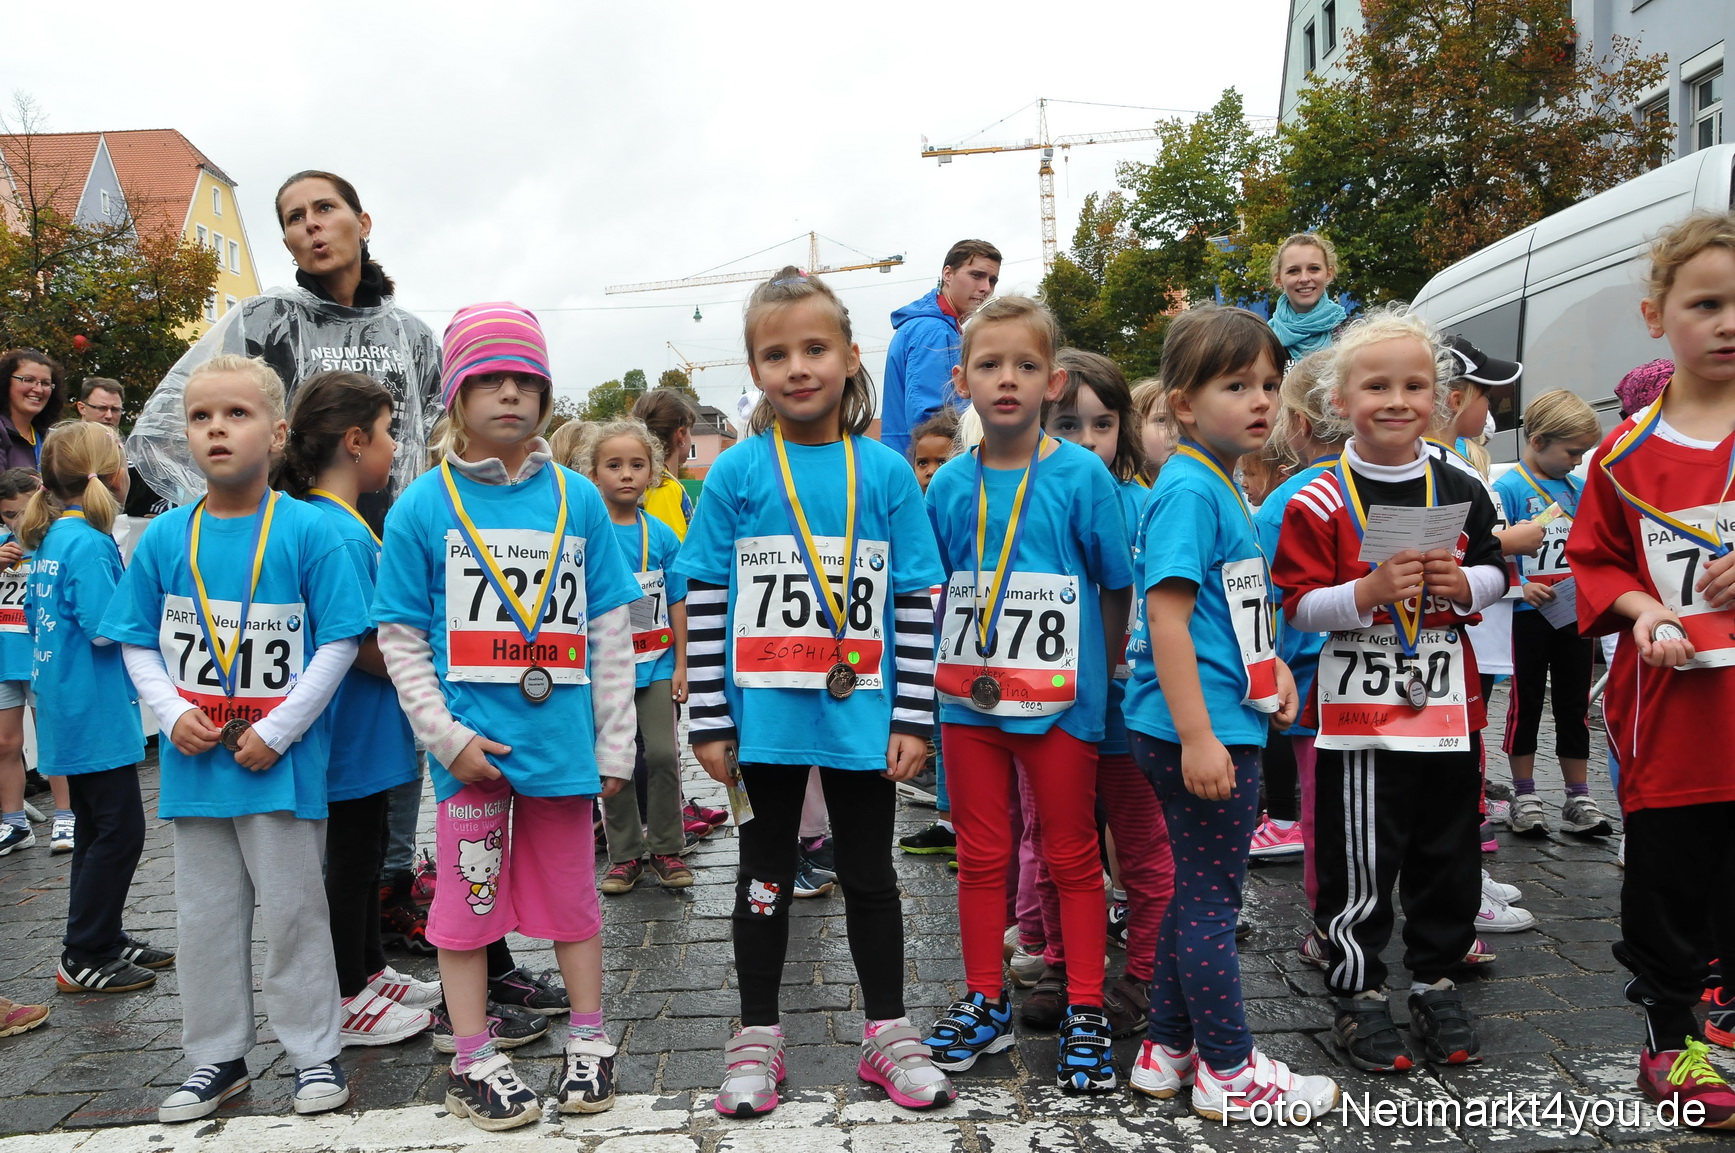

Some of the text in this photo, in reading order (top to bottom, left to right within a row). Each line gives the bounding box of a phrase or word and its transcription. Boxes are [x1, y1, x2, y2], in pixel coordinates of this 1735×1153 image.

[741, 551, 786, 566] PARTL
[1227, 573, 1263, 592] PARTL
[985, 588, 1054, 601] Numarkt
[1369, 633, 1440, 646] Neurkt
[492, 638, 559, 661] Hanna
[757, 642, 841, 661] SOPHIA
[173, 631, 291, 690] 7213
[1333, 649, 1451, 698] 7550
[1338, 711, 1388, 727] HANNAH
[1438, 737, 1459, 747] 2009
[448, 802, 482, 820] Hello
[452, 822, 479, 832] Cutie
